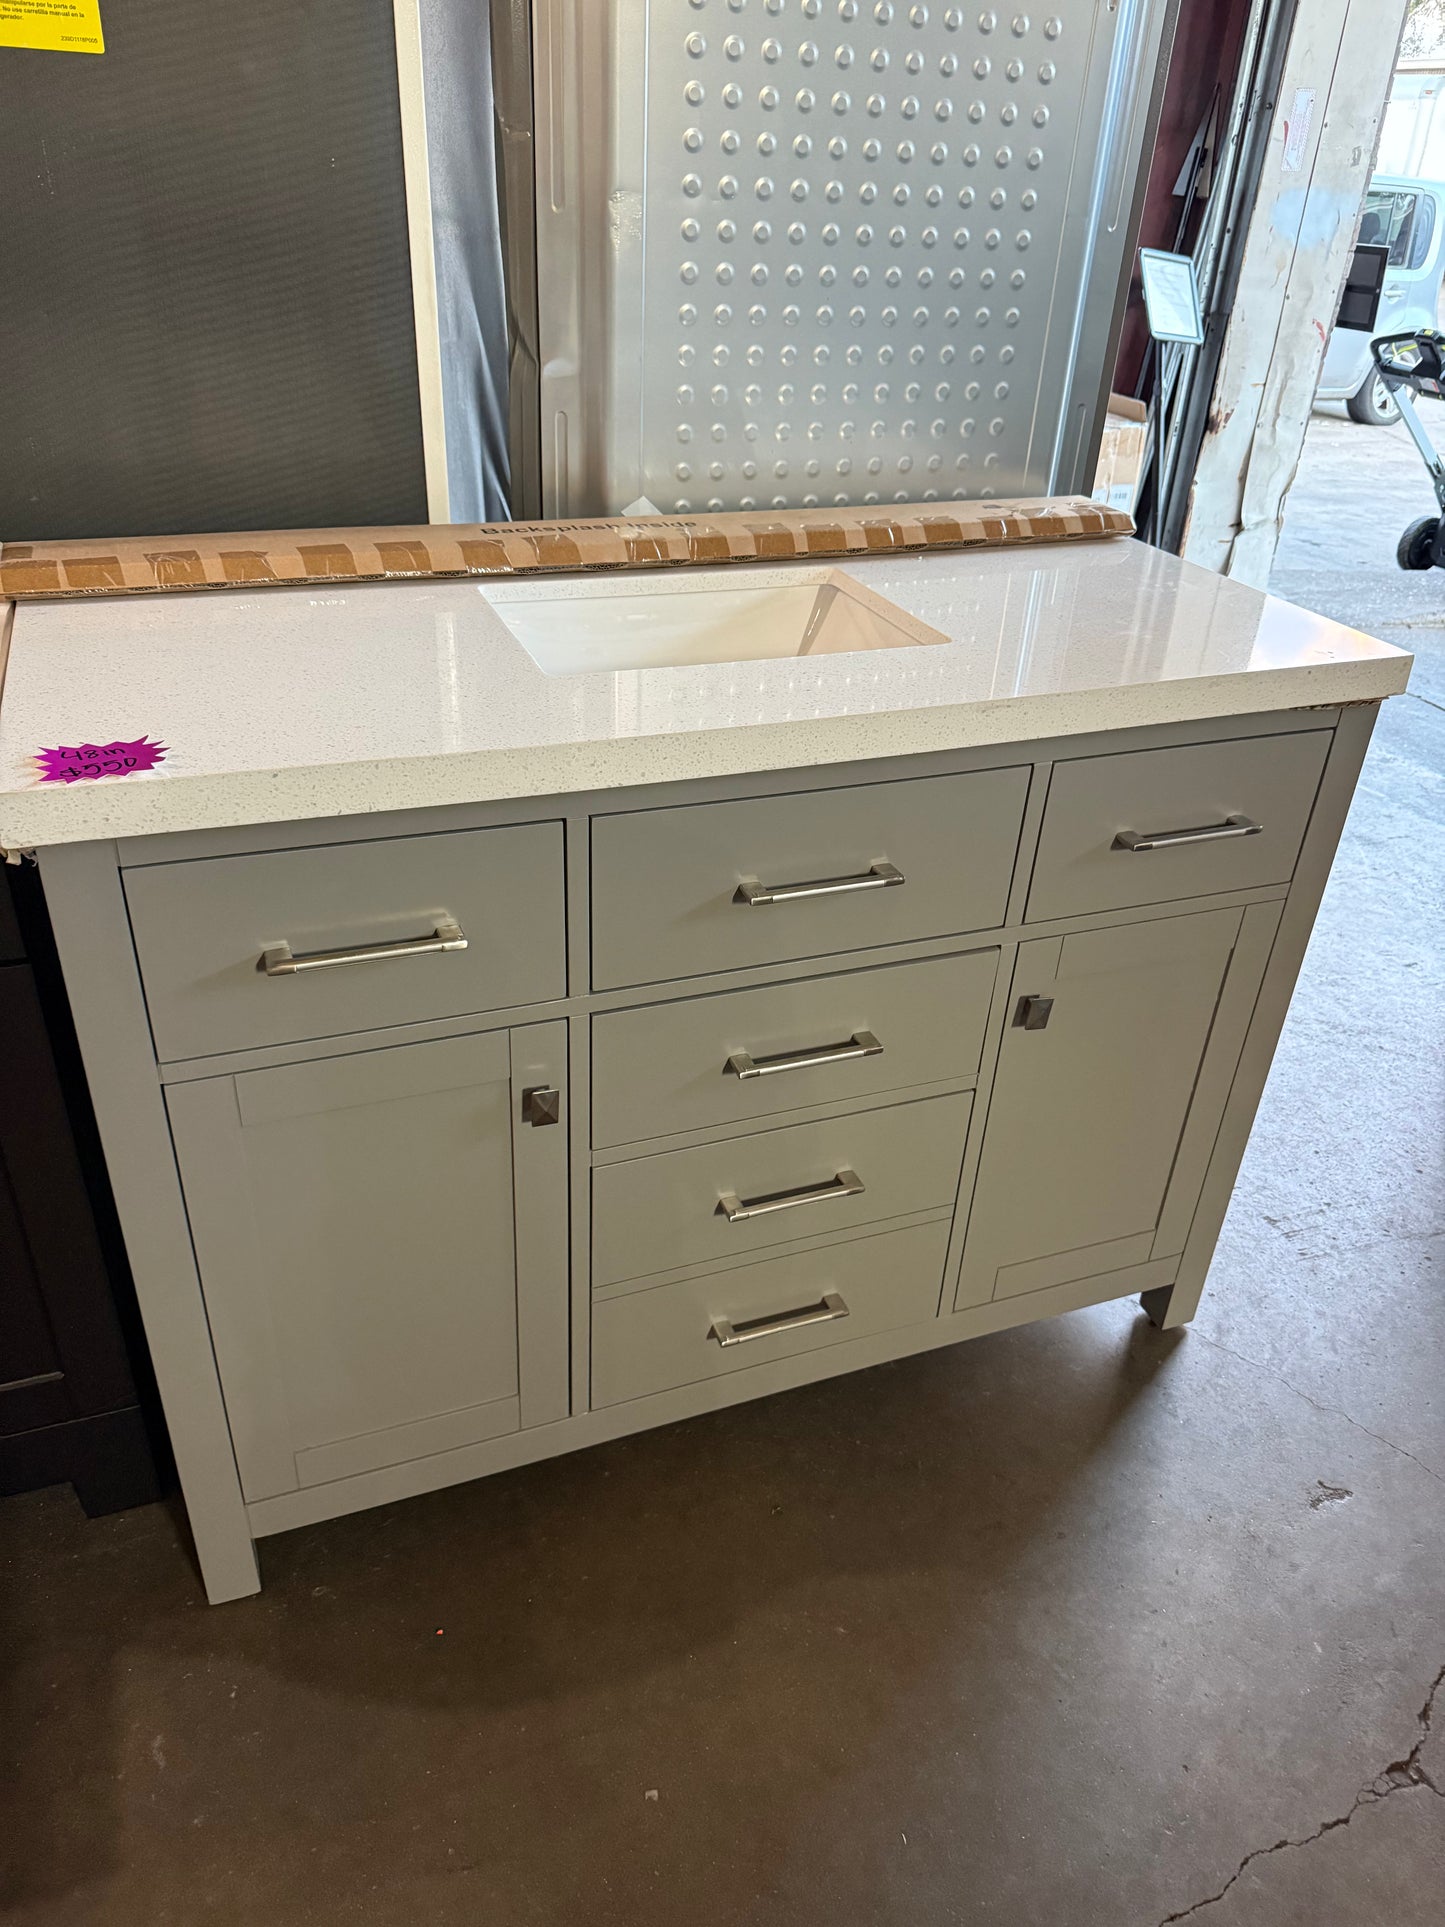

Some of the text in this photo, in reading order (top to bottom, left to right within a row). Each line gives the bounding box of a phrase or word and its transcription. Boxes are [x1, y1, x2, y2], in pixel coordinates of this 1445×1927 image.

[480, 518, 697, 535] Backsplash Inside
[61, 748, 126, 761] 48 in
[59, 757, 138, 777] $550
